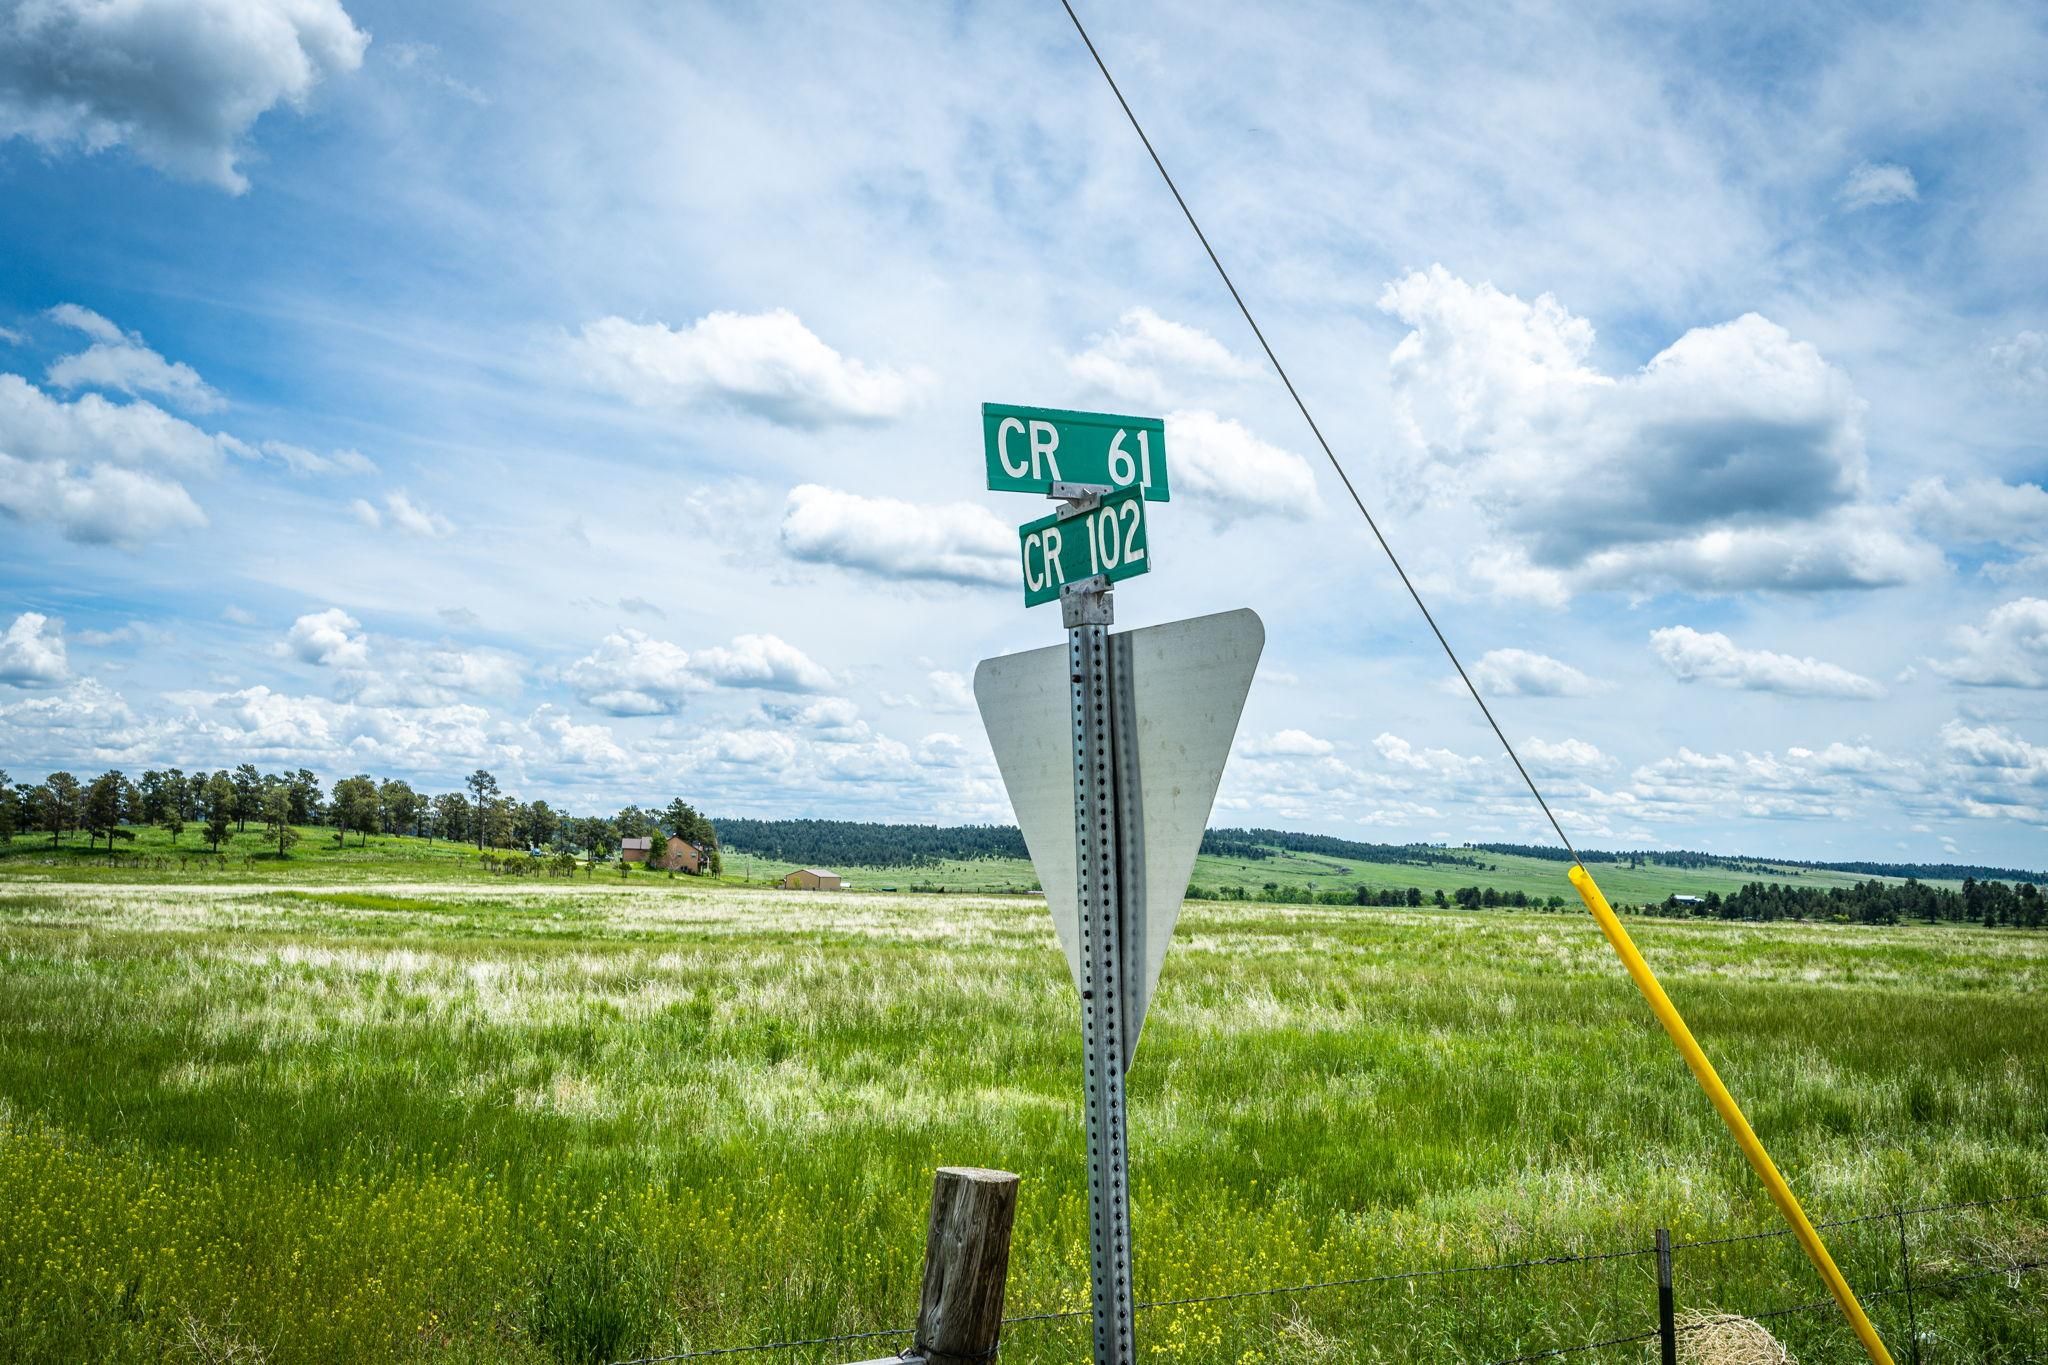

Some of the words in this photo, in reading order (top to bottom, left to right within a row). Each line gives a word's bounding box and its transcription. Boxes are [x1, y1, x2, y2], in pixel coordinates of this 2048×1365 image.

[998, 417, 1062, 481] CR
[1108, 428, 1151, 488] 61
[1024, 527, 1065, 592] CR
[1086, 499, 1145, 575] 102
